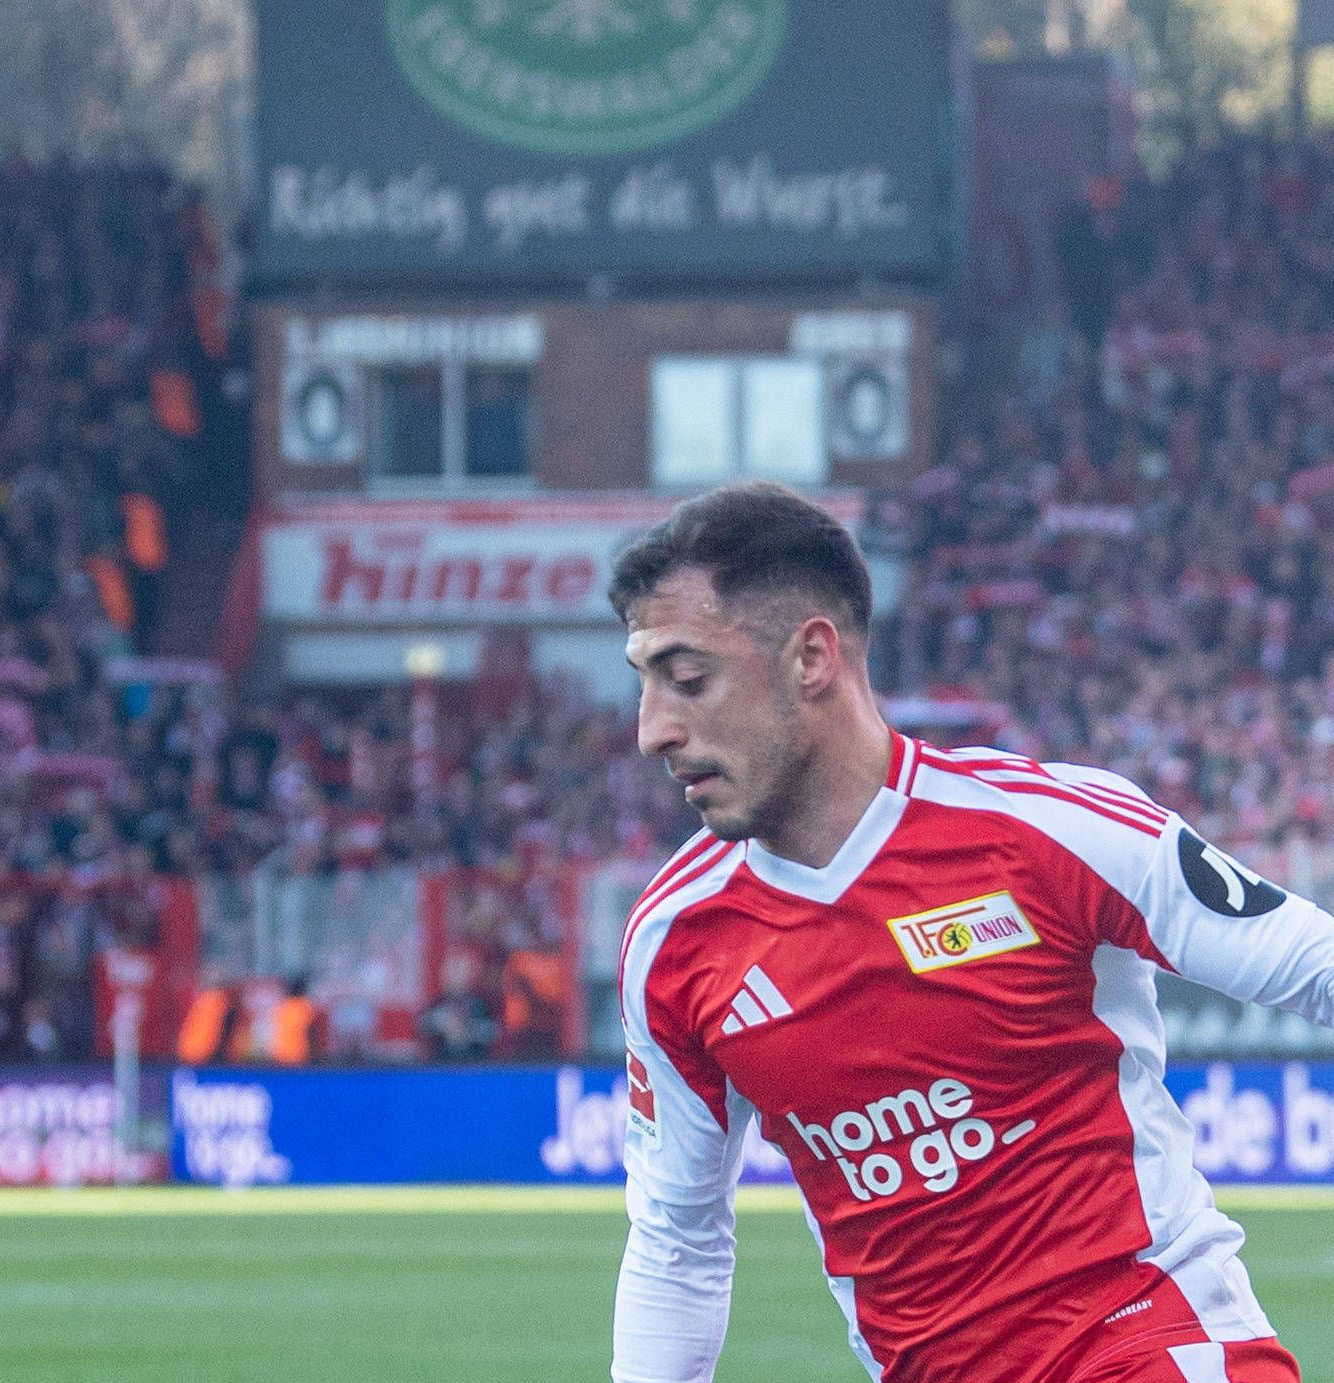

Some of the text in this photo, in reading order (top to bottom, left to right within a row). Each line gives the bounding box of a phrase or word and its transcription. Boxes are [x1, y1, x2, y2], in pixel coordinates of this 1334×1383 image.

[970, 914, 1023, 943] UNION
[786, 1078, 973, 1160] home
[837, 1154, 903, 1200] to
